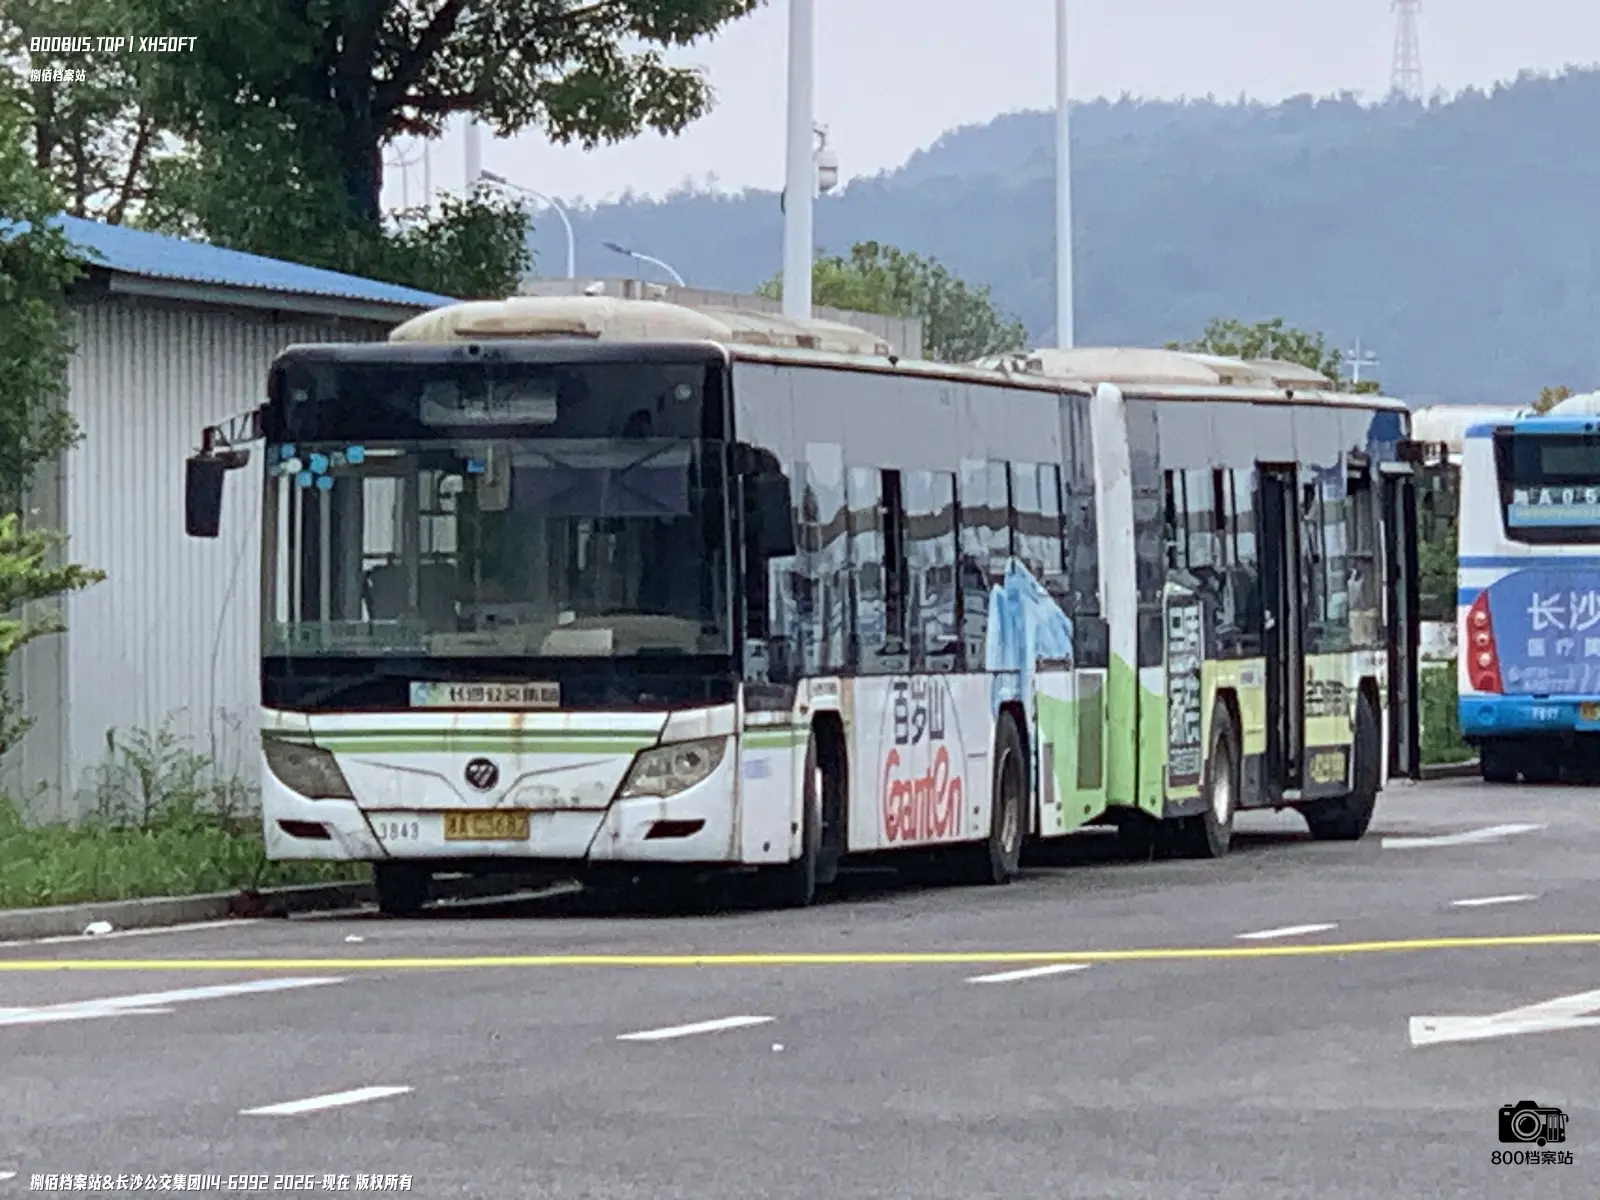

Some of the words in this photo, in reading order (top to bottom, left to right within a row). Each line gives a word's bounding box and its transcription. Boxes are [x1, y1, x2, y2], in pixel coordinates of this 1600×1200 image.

[893, 678, 945, 745] 百岁山
[883, 745, 962, 842] Ganten
